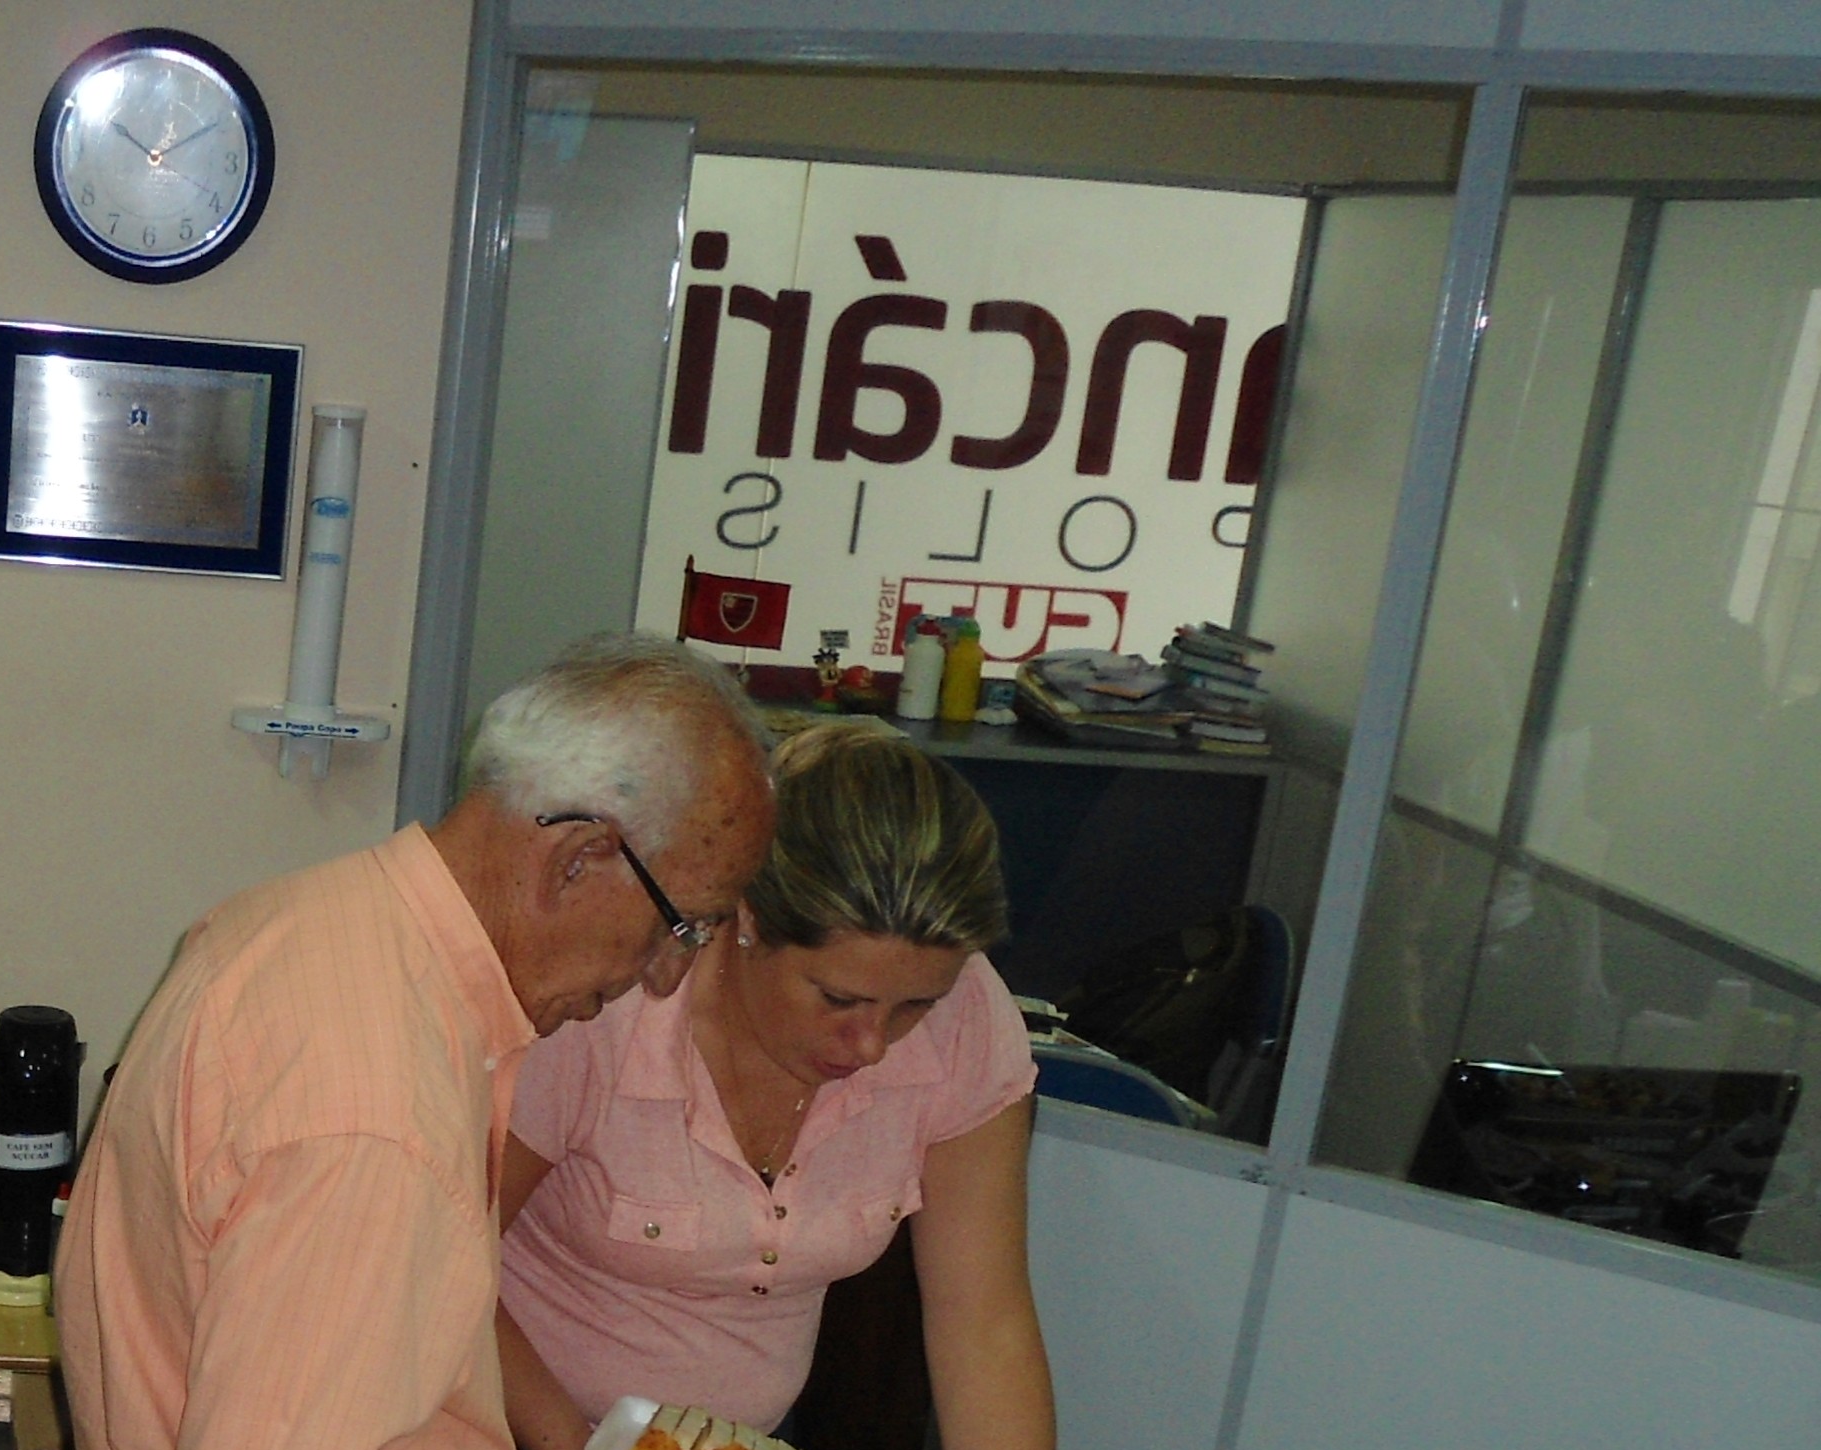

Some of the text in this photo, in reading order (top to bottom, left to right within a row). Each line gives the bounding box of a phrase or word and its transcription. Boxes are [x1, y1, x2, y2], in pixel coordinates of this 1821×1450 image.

[225, 151, 238, 175] 3
[208, 191, 223, 214] 4
[108, 213, 121, 236] 7
[179, 218, 193, 241] 5
[143, 226, 156, 249] 6
